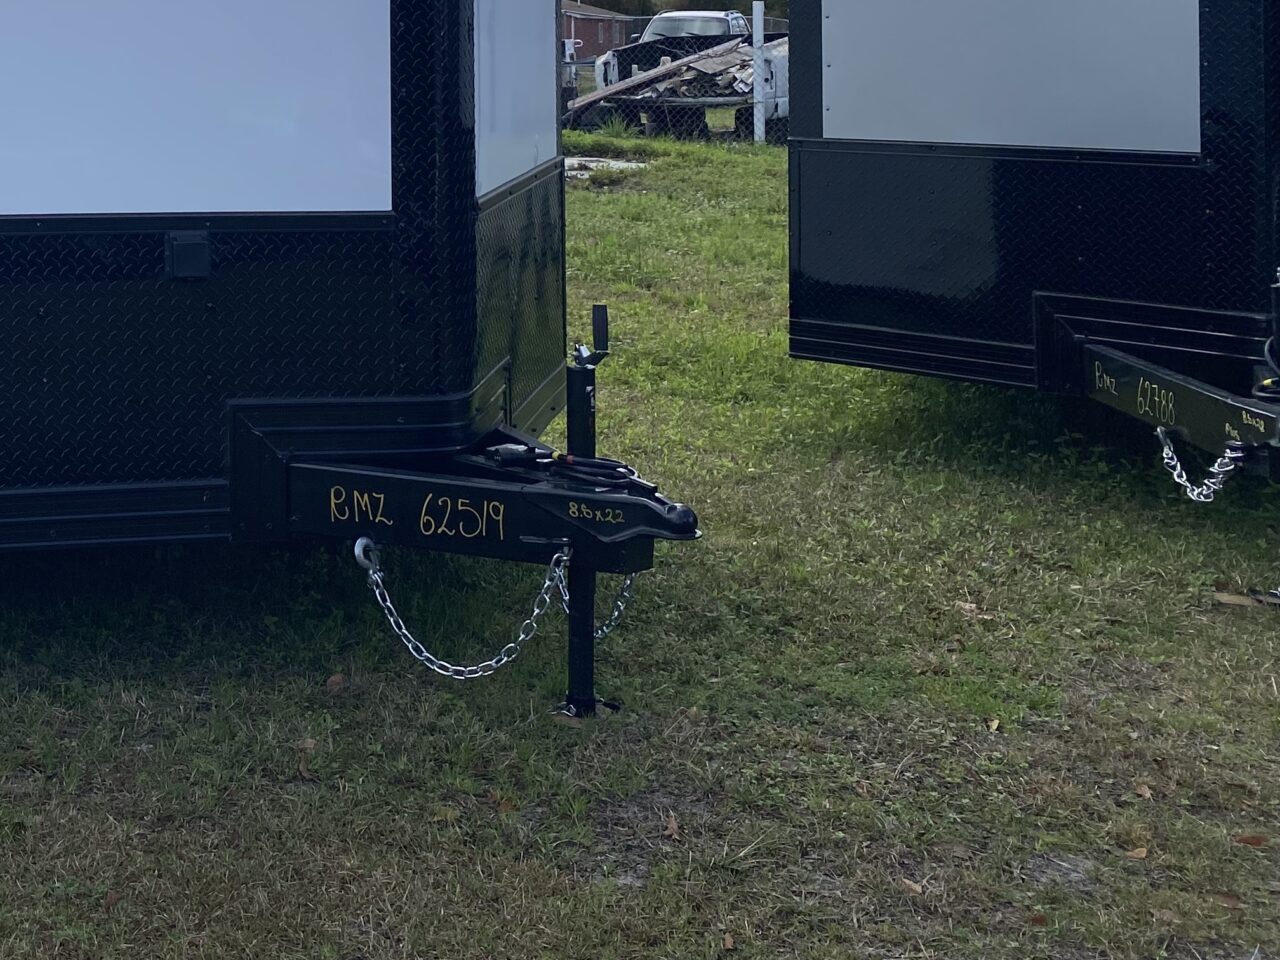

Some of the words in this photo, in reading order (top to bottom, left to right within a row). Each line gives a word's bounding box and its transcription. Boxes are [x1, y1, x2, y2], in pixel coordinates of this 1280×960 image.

[1137, 376, 1176, 425] 62788
[330, 484, 394, 527] RMZ
[419, 492, 505, 541] 62519
